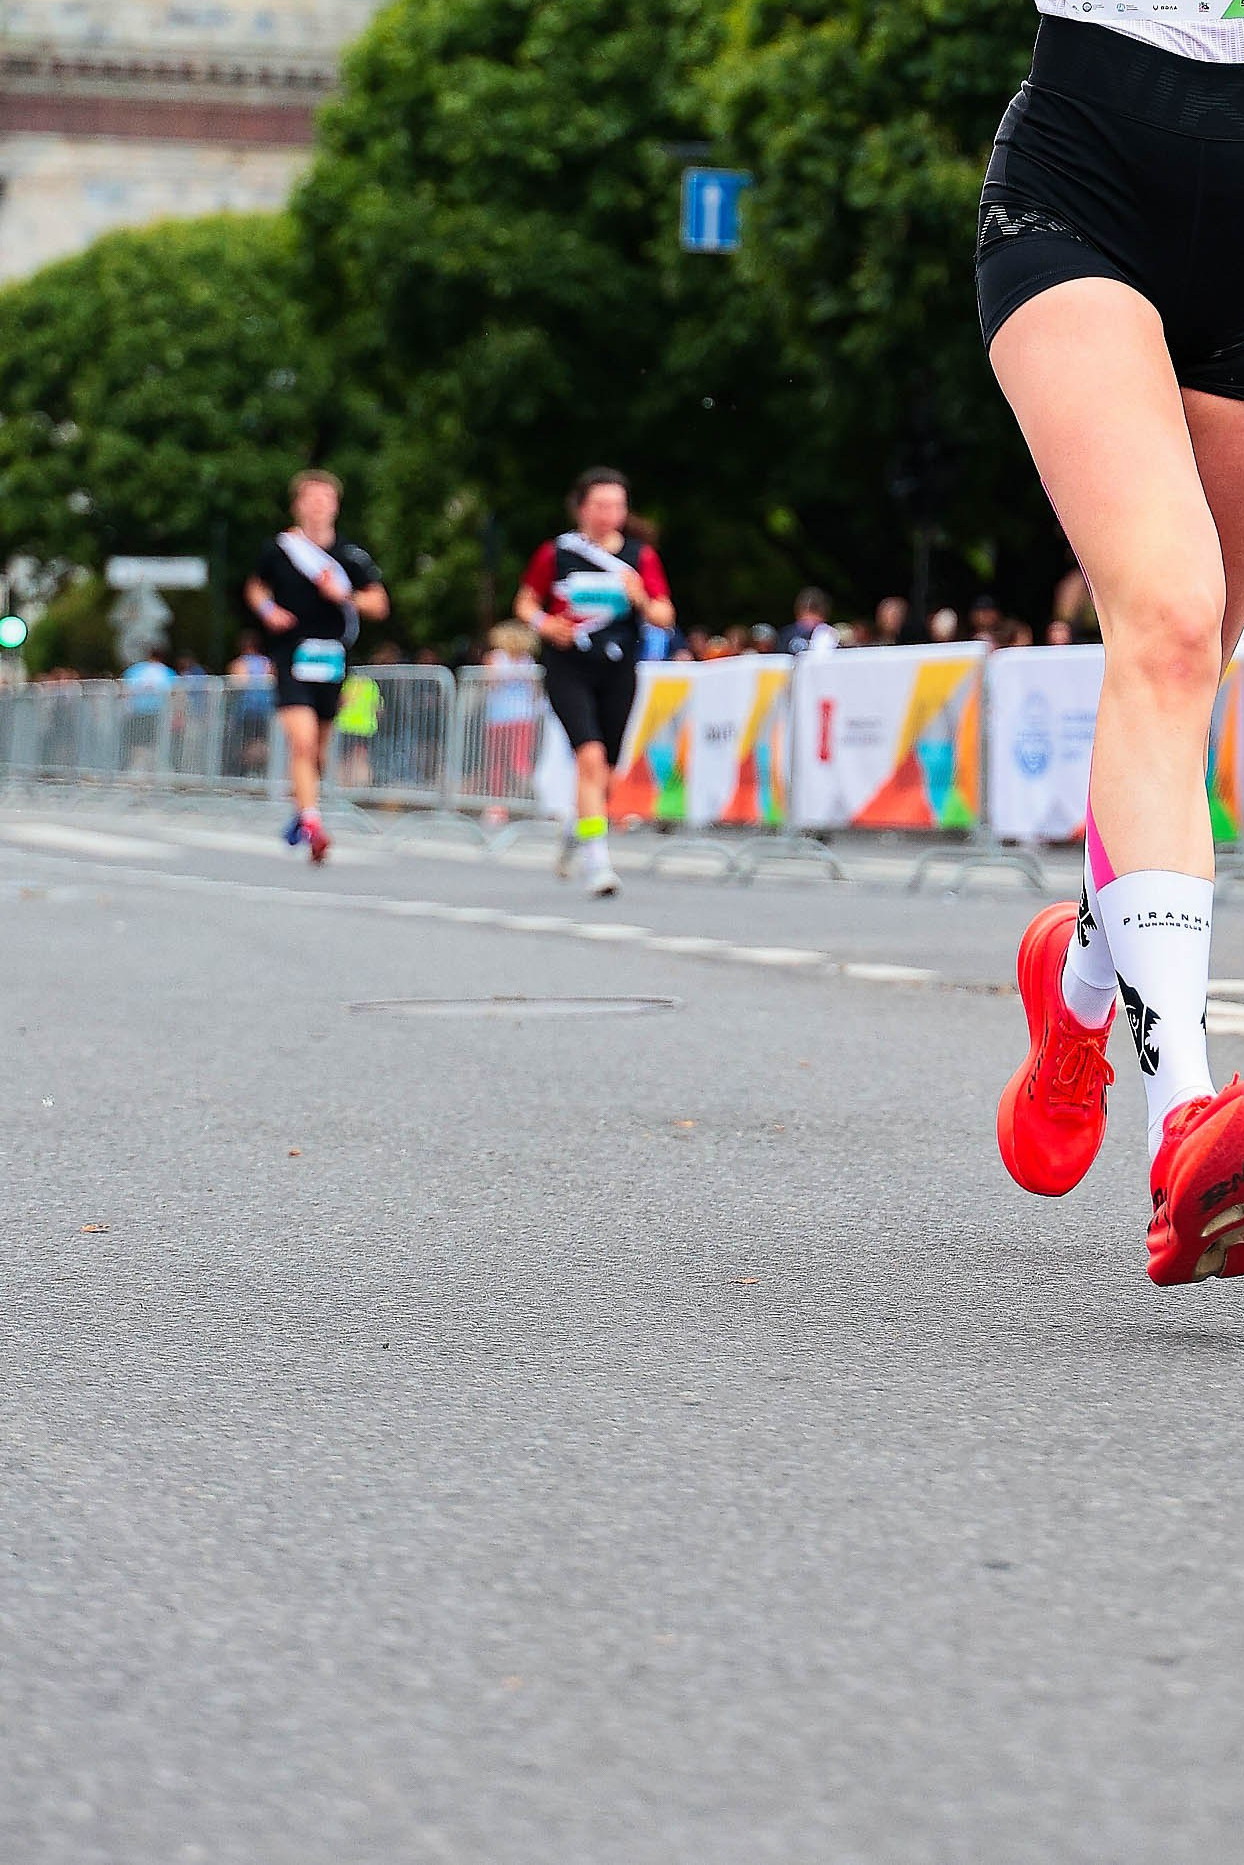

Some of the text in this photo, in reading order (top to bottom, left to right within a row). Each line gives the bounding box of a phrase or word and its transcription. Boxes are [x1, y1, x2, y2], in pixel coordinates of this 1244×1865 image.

[1123, 911, 1210, 928] PIRANHA
[1138, 921, 1202, 931] RUNNING CLUB
